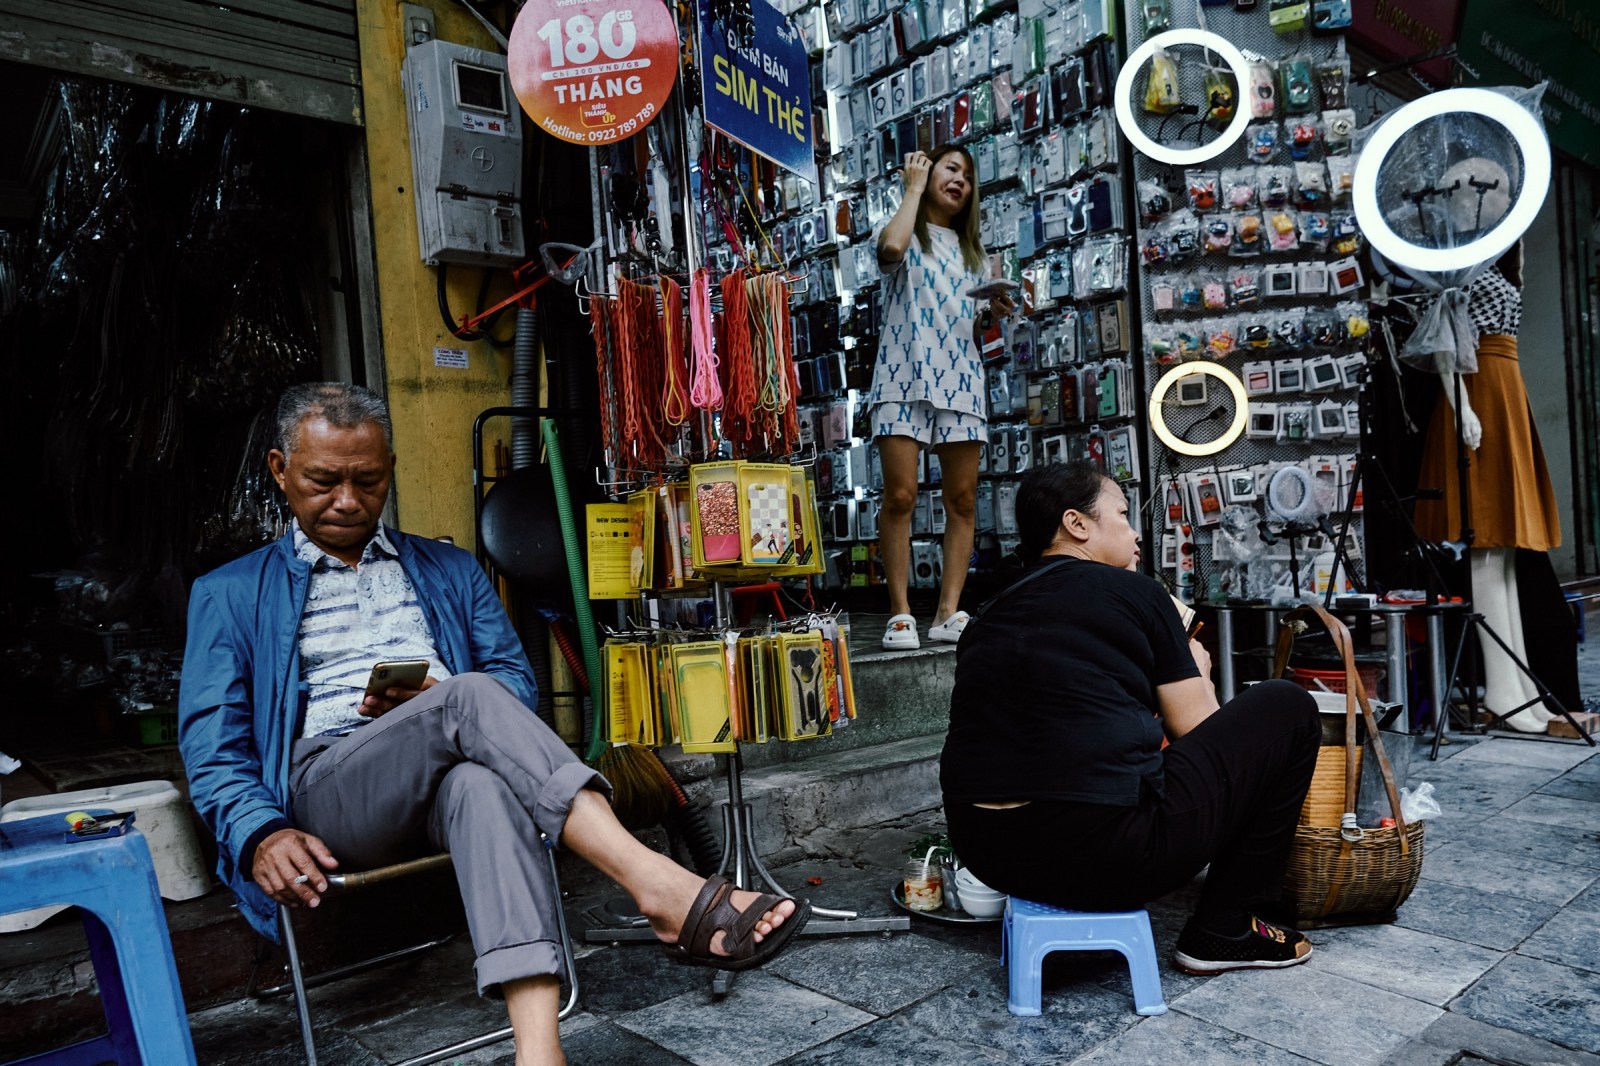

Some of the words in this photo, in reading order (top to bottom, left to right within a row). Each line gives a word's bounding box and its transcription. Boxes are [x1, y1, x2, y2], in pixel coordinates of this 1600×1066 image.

[616, 9, 633, 22] GB
[536, 10, 637, 68] 180
[553, 75, 643, 104] THÁNG
[763, 56, 789, 88] BÁN
[713, 54, 759, 115] SIM
[762, 85, 806, 143] THẺ
[542, 117, 586, 142] Hotline:
[588, 128, 617, 142] 0922
[617, 118, 638, 136] 789
[635, 102, 655, 123] 789
